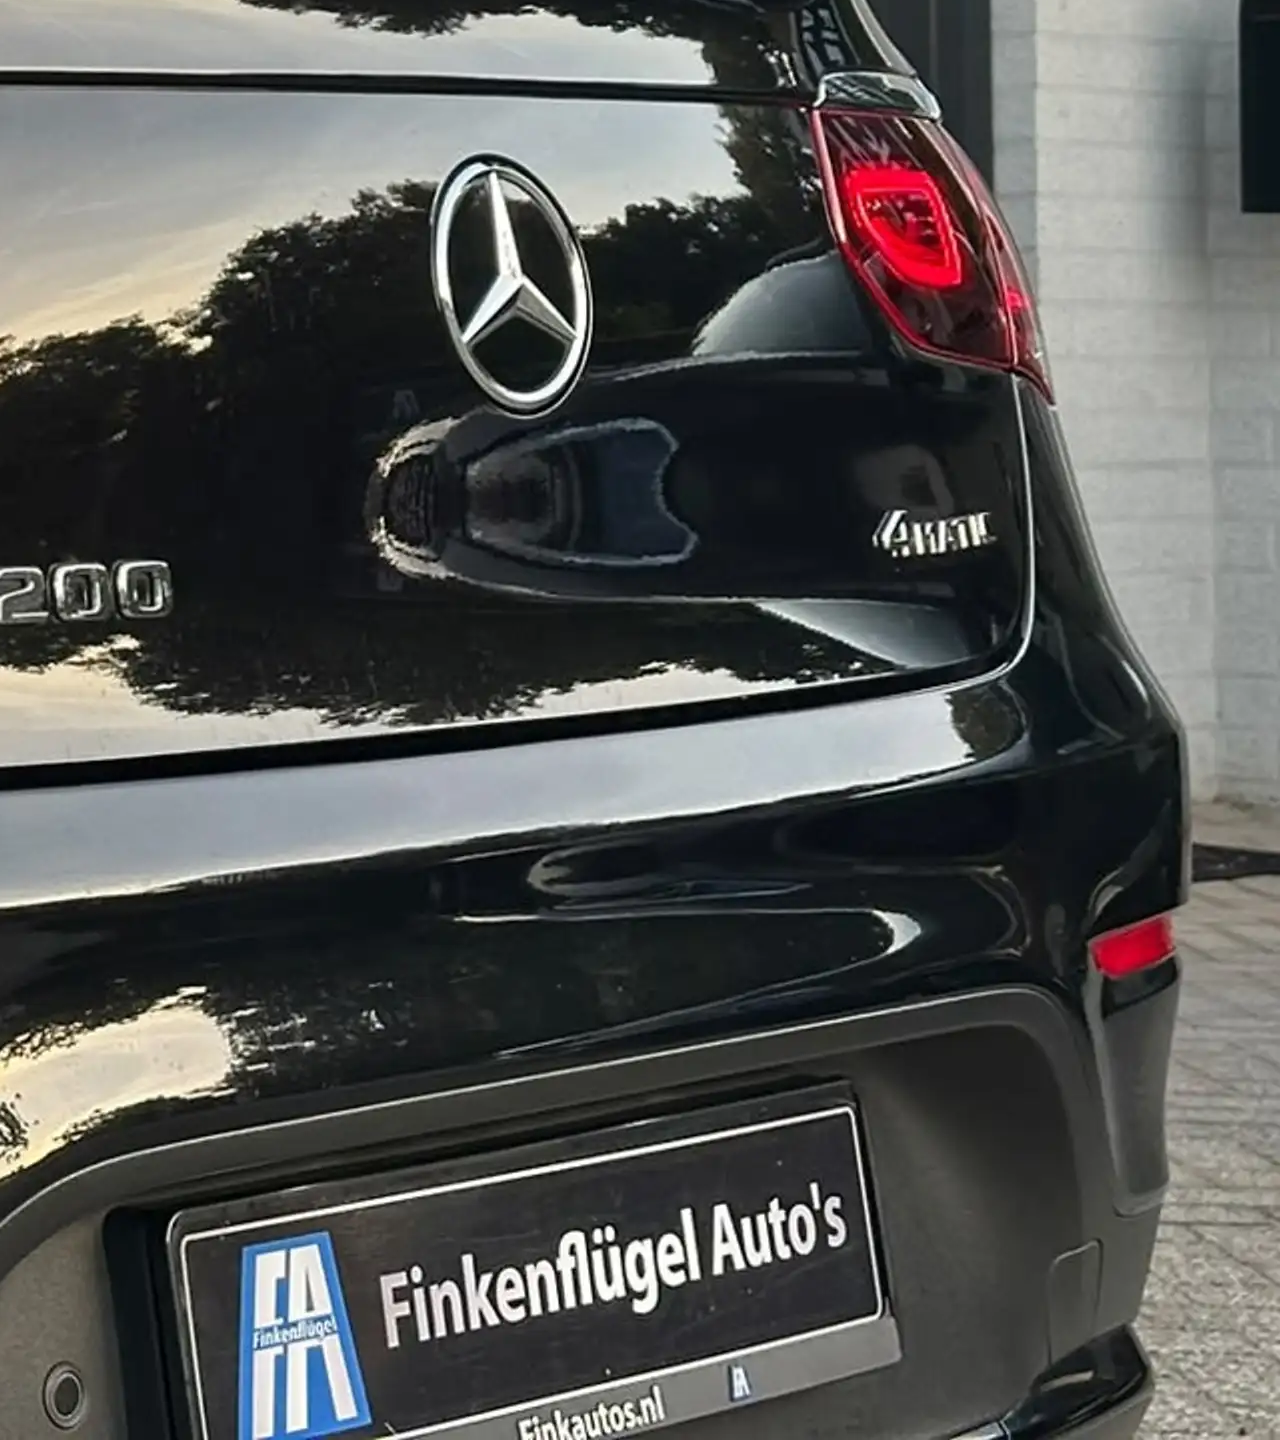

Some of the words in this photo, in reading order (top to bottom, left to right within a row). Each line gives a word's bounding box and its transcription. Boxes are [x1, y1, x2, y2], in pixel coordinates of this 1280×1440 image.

[378, 1206, 703, 1350] Finkenflügel
[711, 1181, 849, 1278] Auto's
[252, 1314, 338, 1350] Finkenflügel
[517, 1382, 668, 1440] Finkautos.nl
